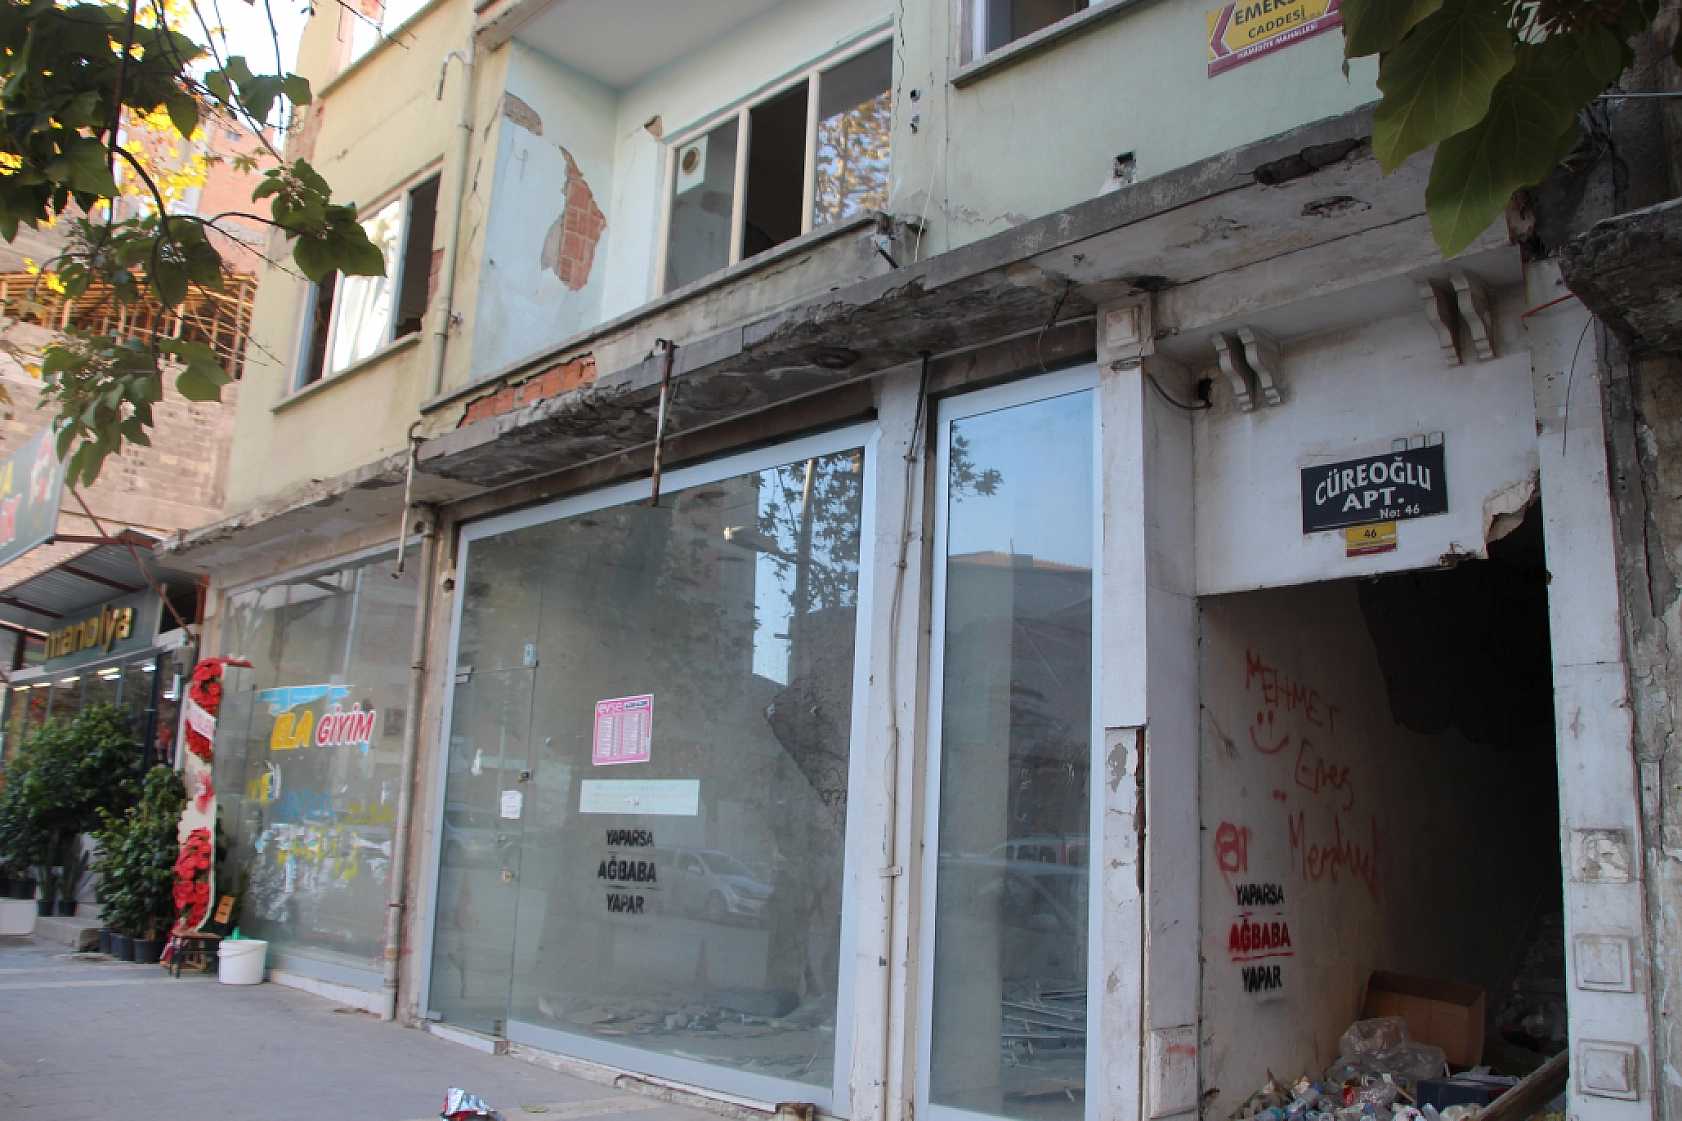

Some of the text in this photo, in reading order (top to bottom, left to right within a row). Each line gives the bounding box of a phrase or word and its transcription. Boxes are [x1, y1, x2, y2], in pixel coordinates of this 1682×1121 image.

[1342, 486, 1405, 513] APT.
[1379, 503, 1420, 519] No: 46
[1363, 528, 1377, 538] 46
[45, 604, 133, 659] manolya
[270, 703, 376, 750] ELA GİYİM
[606, 829, 655, 848] YAPARSA
[597, 855, 657, 883] AĞBABA
[606, 893, 645, 914] YAPAR
[1236, 883, 1285, 906] YAPARSA
[1228, 917, 1292, 953] AĞBABA
[1242, 965, 1283, 993] YAPAR
